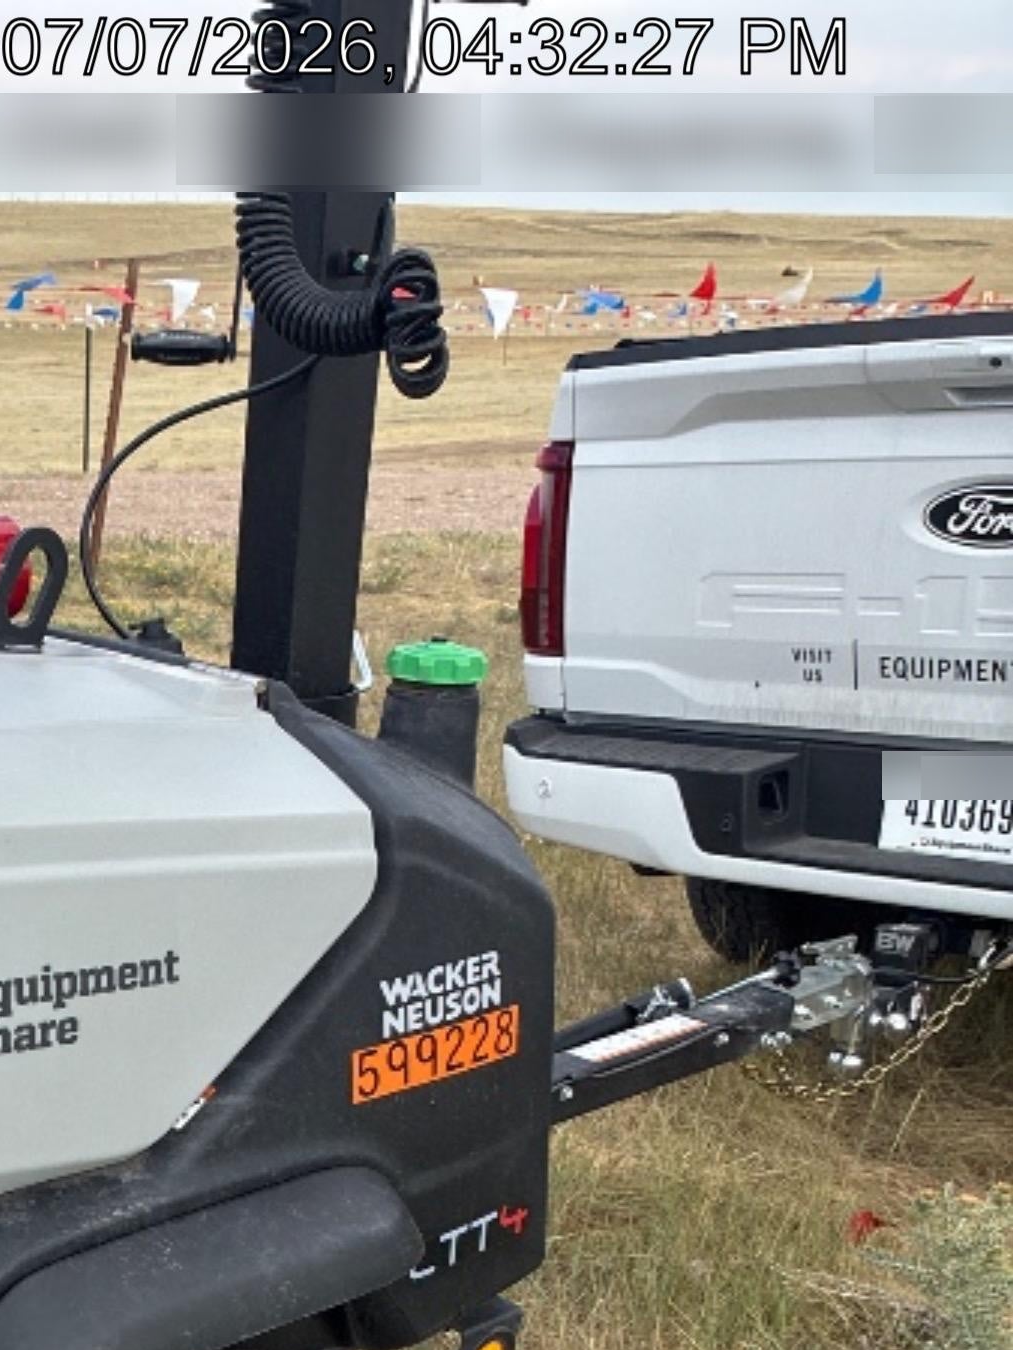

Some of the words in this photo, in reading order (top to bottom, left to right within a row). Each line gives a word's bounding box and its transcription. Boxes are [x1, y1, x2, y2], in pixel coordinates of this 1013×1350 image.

[948, 494, 1013, 534] For
[790, 648, 832, 664] VISIT
[803, 668, 823, 683] US
[879, 655, 1013, 682] EQUIPMEN
[379, 949, 501, 1006] WACKER
[382, 977, 502, 1039] NEUSON
[358, 1010, 513, 1097] 599228
